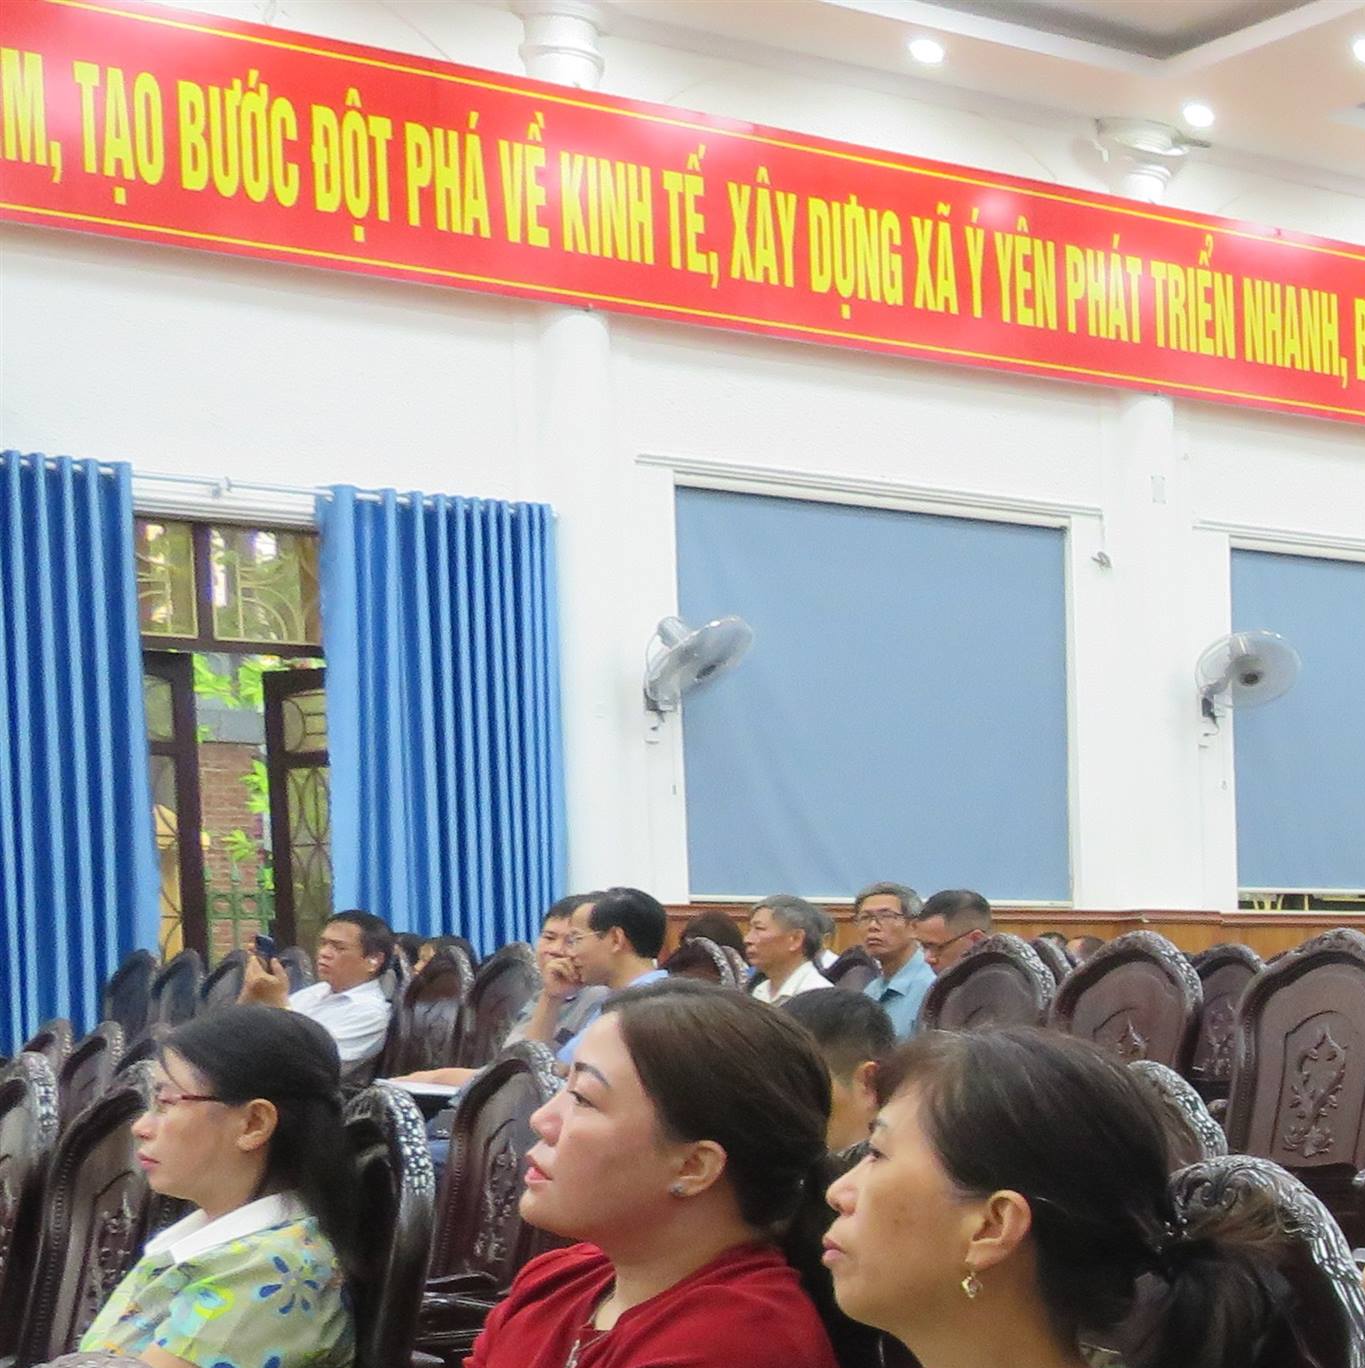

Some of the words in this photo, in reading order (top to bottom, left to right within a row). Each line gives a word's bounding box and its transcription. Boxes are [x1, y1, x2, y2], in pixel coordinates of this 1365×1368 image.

[73, 61, 165, 204] TẠO
[177, 70, 300, 207] BƯỚC
[310, 88, 393, 241] ĐỘT
[404, 112, 492, 240] PHÁ
[498, 111, 551, 248] VỀ
[559, 151, 655, 265] KINH
[661, 144, 720, 288] TẾ,
[727, 166, 798, 288] XÂY
[806, 194, 904, 320] DỰNG
[911, 202, 960, 316] XÃ
[964, 207, 986, 319] Ý
[993, 216, 1058, 331] YÊN
[1064, 234, 1143, 344] PHÁT
[1150, 234, 1236, 359] TRIỂN
[1242, 277, 1348, 388] NHANH,
